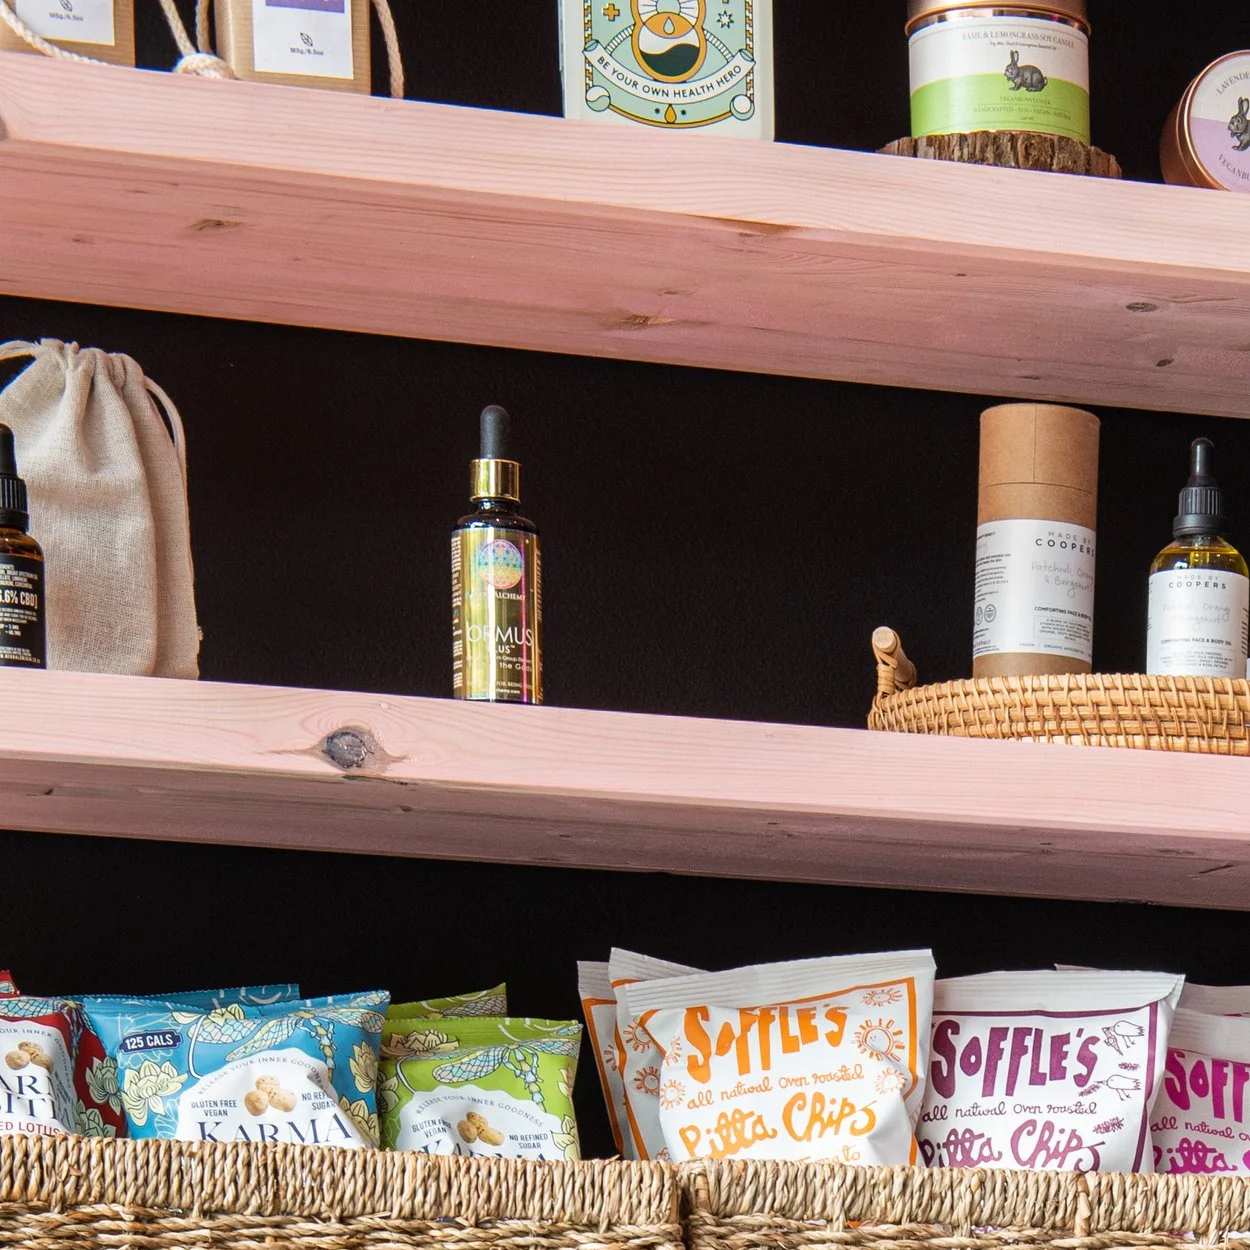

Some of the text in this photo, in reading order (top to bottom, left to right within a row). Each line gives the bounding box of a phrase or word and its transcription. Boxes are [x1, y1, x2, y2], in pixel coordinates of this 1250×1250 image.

[597, 56, 742, 98] BE YOUR OWN HEALTH HERO
[1168, 581, 1226, 590] COOPERS
[125, 1034, 174, 1050] 125 CALS
[231, 1059, 254, 1072] YOUR
[258, 1056, 288, 1065] INNER
[687, 1089, 715, 1110] all
[720, 1076, 773, 1099] natural
[812, 1063, 864, 1084] roasted
[191, 1099, 237, 1108] GLUTEN FREE
[301, 1092, 312, 1101] NO
[204, 1109, 228, 1117] VEGAN
[312, 1101, 336, 1111] SUGAR
[467, 1096, 495, 1107] INNER
[498, 1103, 545, 1127] GOODNESS
[922, 1105, 948, 1123] all
[955, 1101, 1006, 1118] natural
[1047, 1102, 1097, 1115] roasted
[782, 1091, 878, 1142] Chips
[197, 1113, 352, 1143] KARMA
[412, 1119, 437, 1133] GLUTEN
[424, 1127, 447, 1138] VEGAN
[1150, 1116, 1178, 1132] all
[1184, 1121, 1235, 1139] natural
[520, 1133, 549, 1141] REFINED
[1010, 1119, 1106, 1174] Chips
